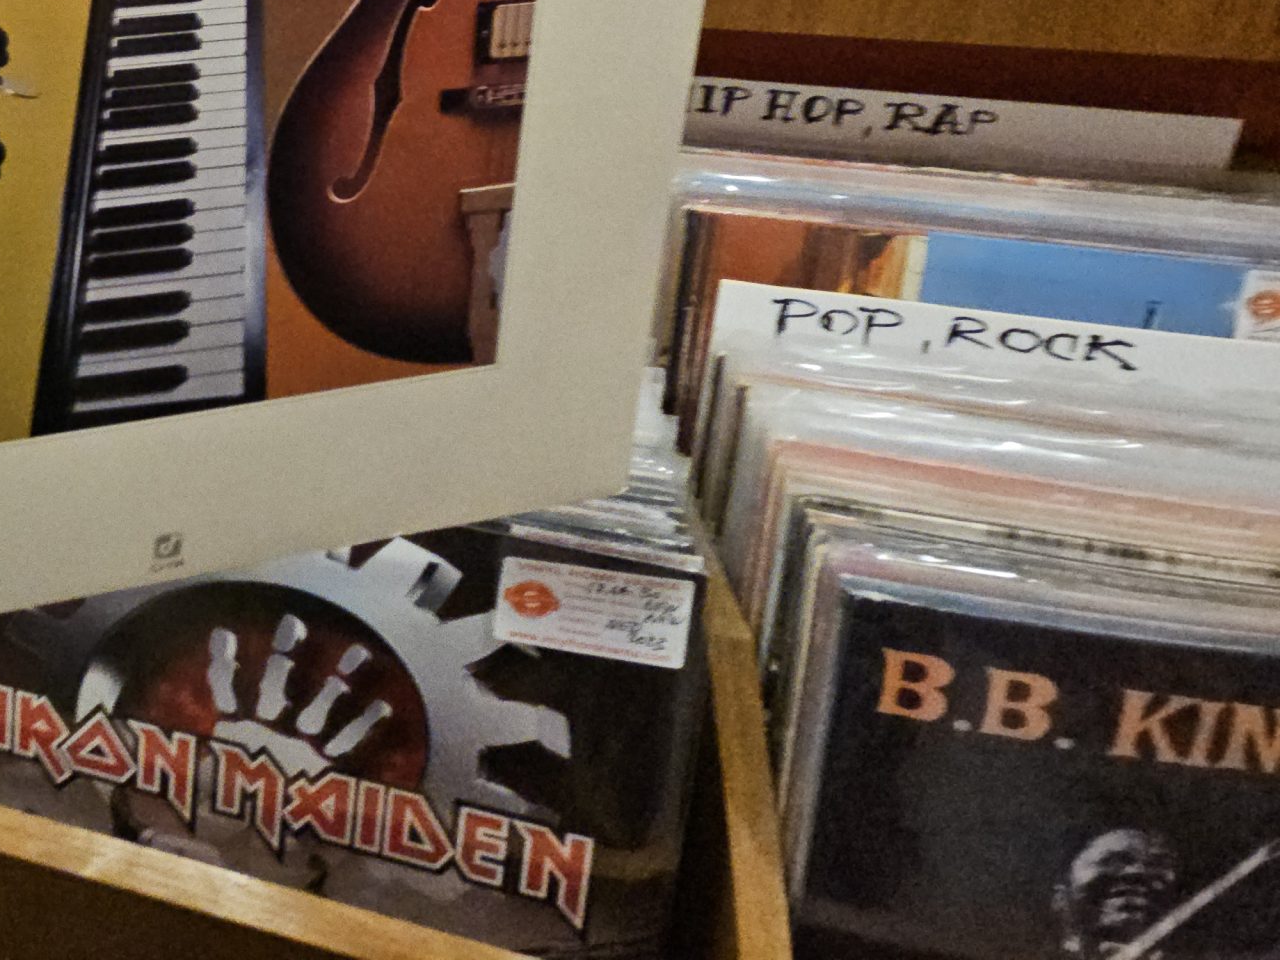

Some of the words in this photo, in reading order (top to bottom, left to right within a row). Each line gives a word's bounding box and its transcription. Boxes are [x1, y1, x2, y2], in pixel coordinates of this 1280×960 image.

[687, 83, 753, 116] IP
[883, 101, 999, 135] RAP
[946, 316, 1138, 371] ROCK
[874, 646, 1075, 751] B.B.
[1105, 688, 1280, 773] KIN
[211, 738, 596, 932] MAIDEN
